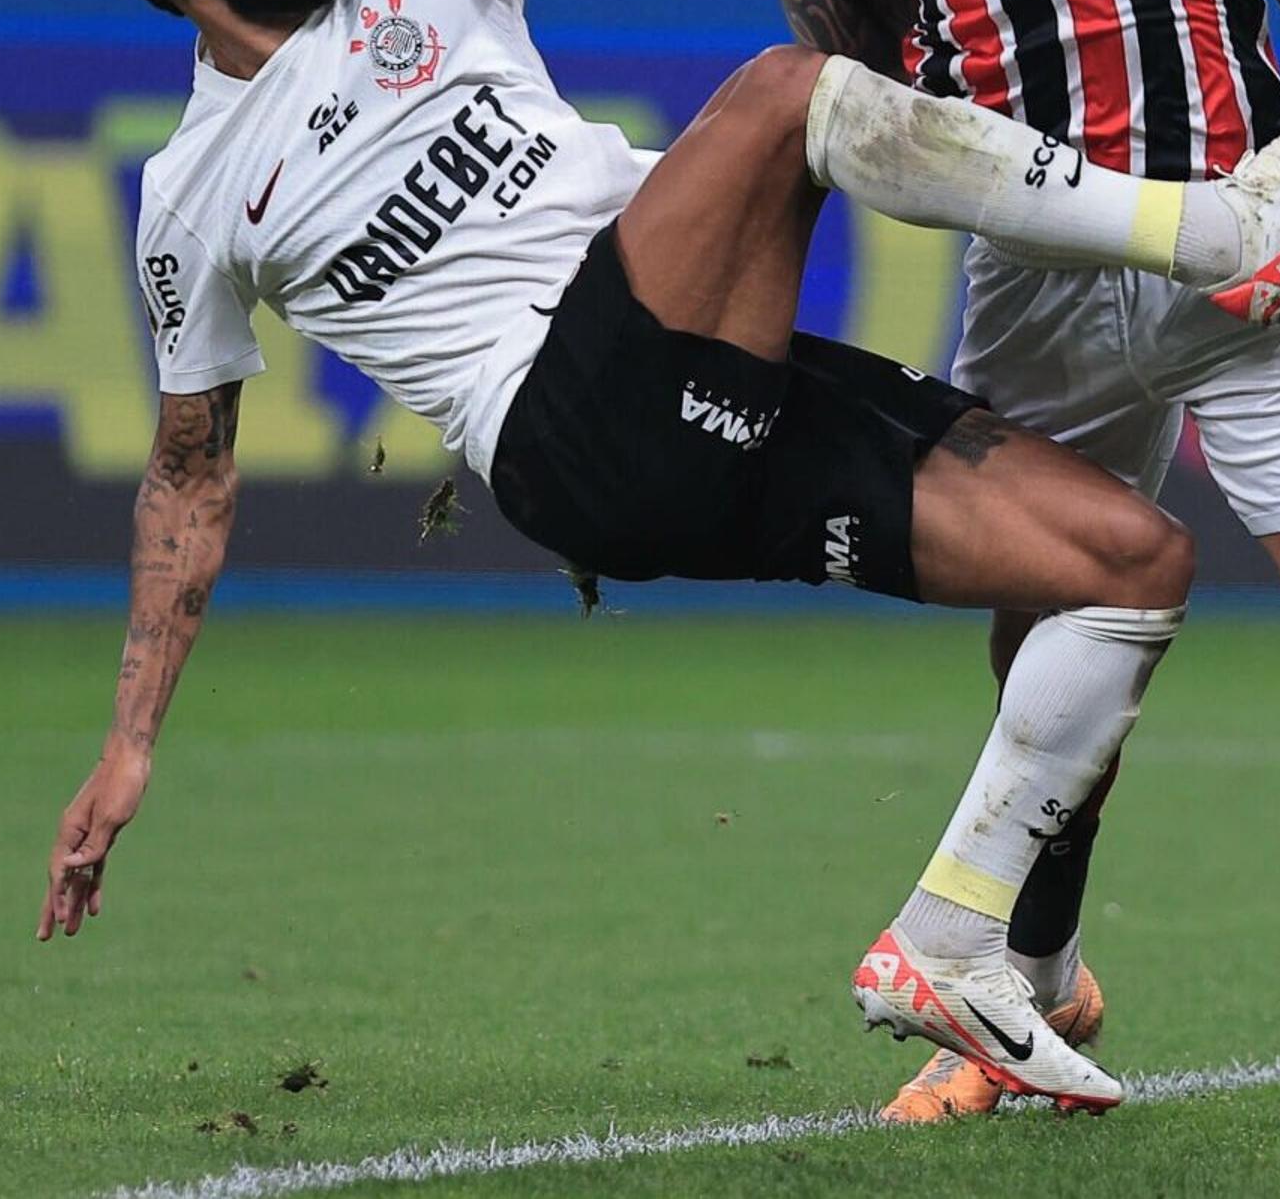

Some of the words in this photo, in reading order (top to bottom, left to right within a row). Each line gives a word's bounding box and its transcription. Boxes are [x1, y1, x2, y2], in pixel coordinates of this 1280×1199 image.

[318, 100, 360, 156] ALE
[1024, 132, 1061, 190] SCC
[324, 85, 528, 303] VAIDEBET
[492, 132, 558, 219] .COM
[145, 253, 187, 330] bmg
